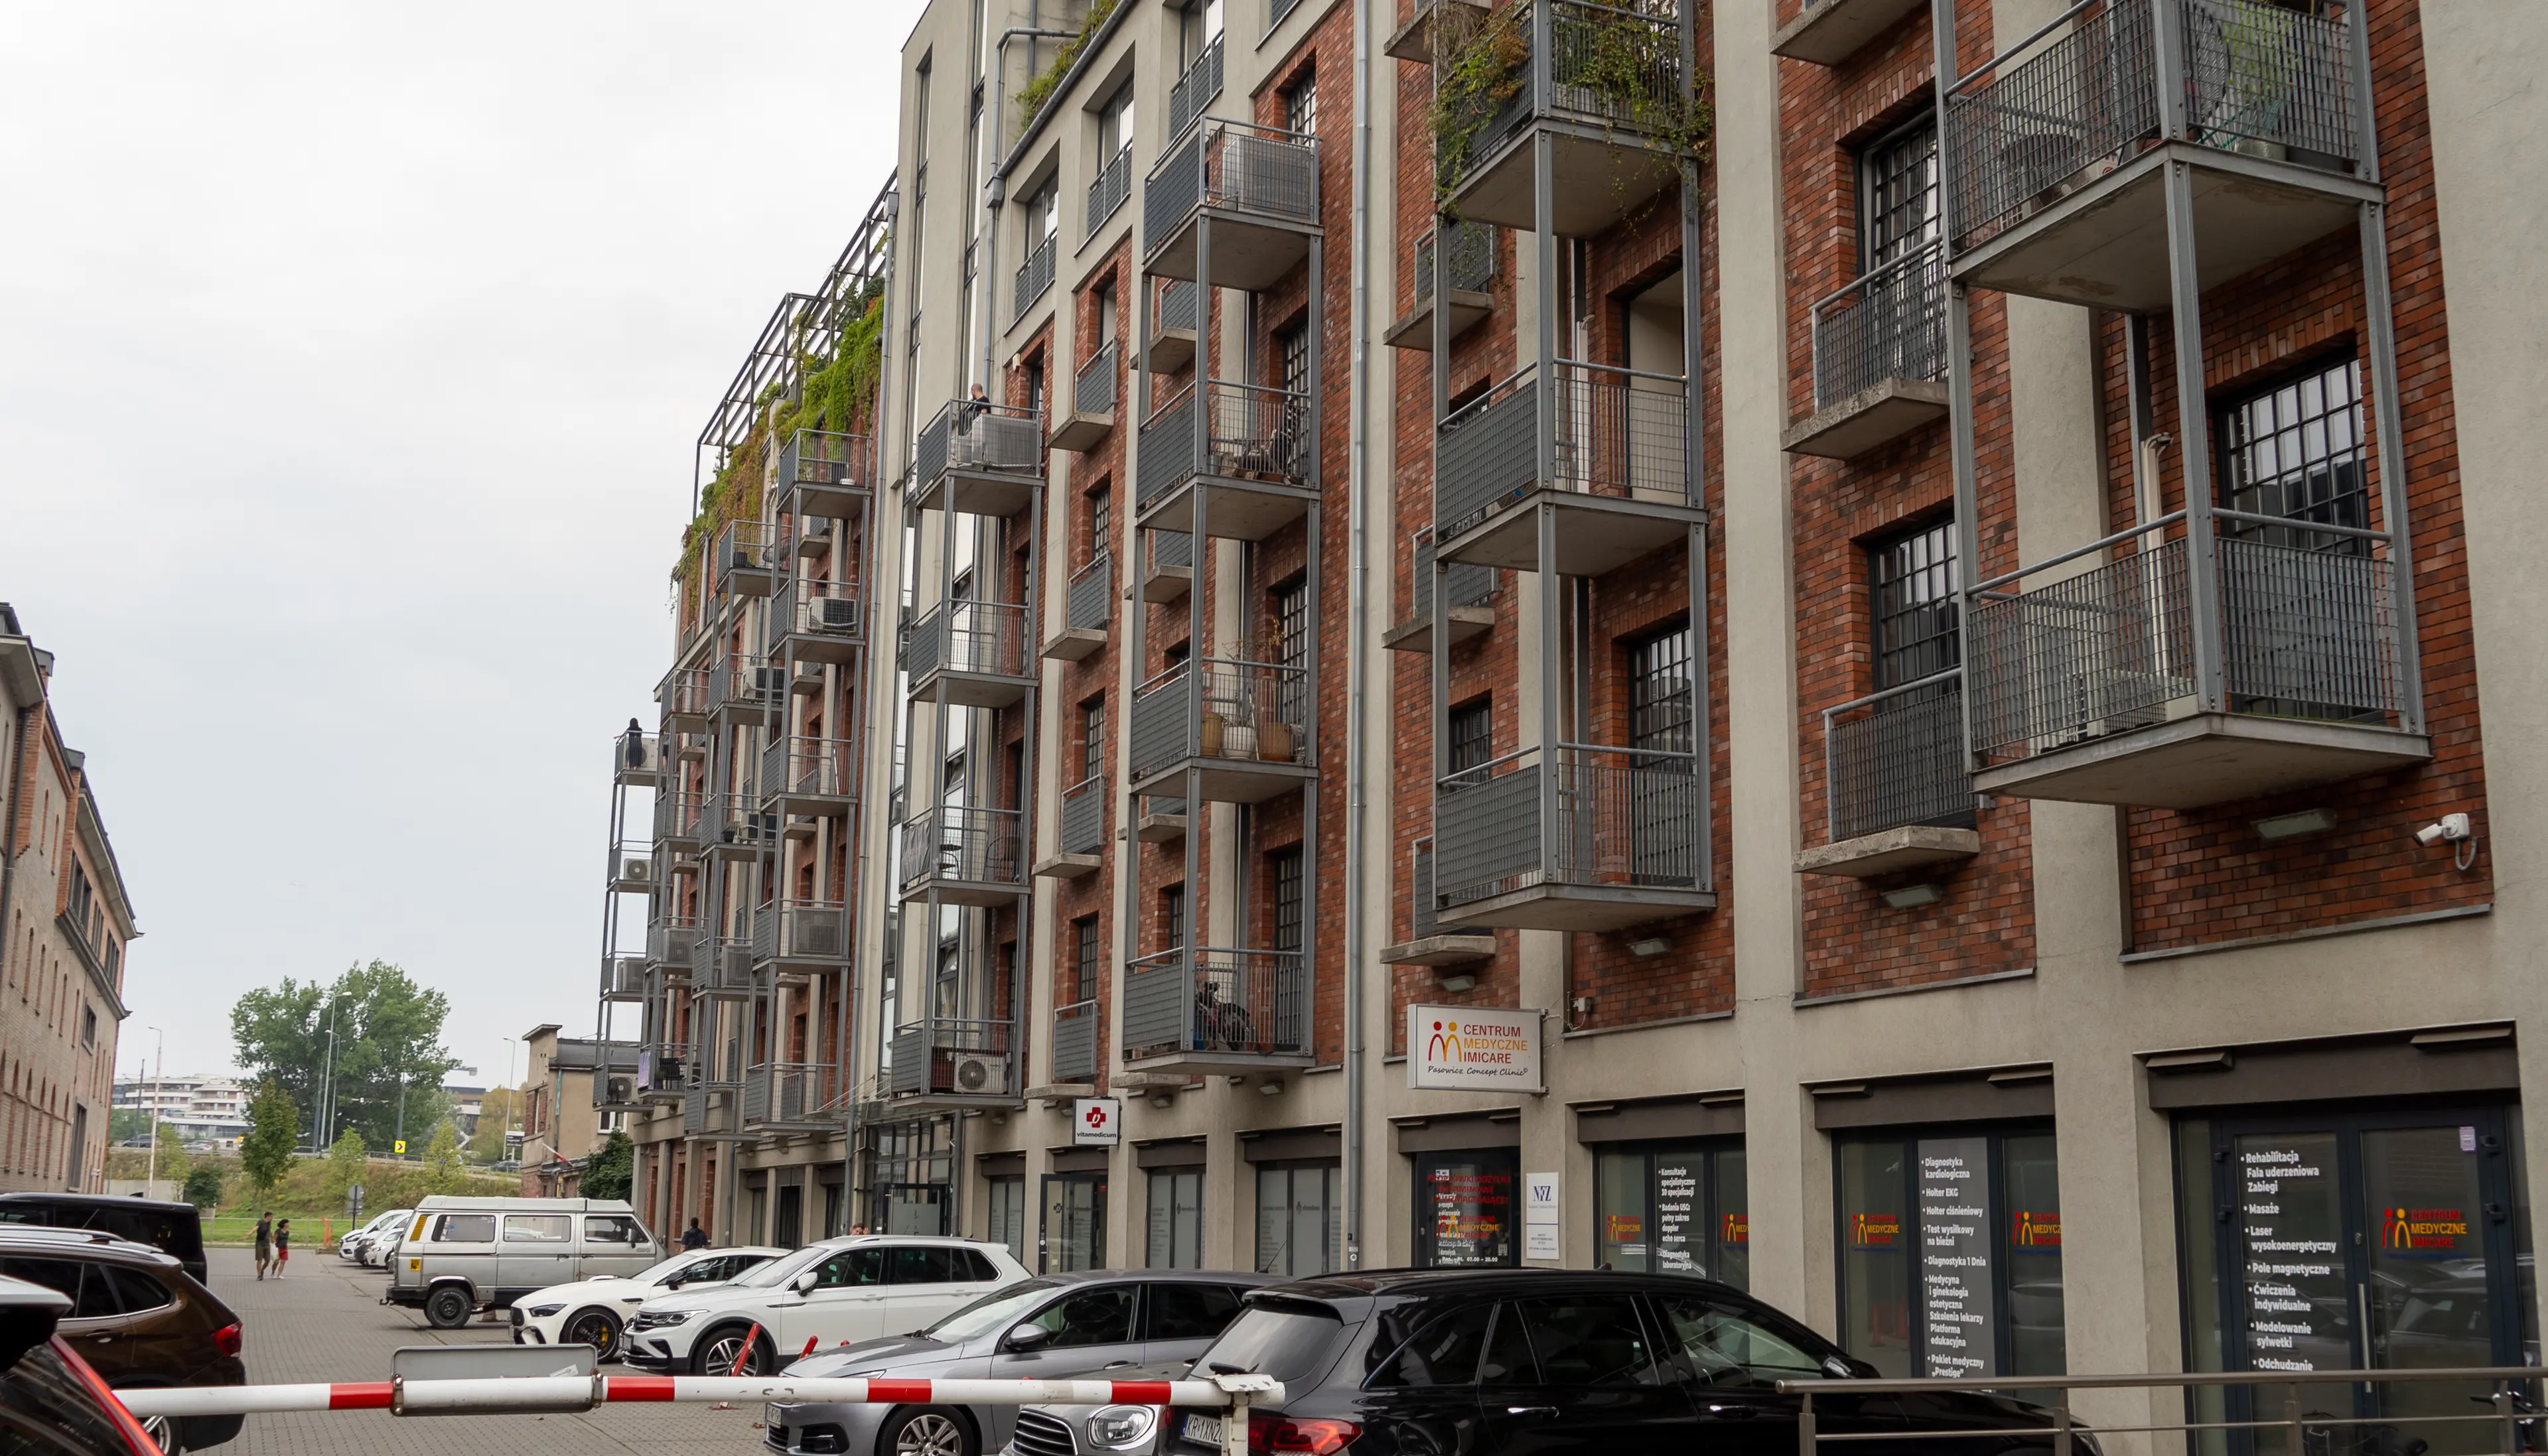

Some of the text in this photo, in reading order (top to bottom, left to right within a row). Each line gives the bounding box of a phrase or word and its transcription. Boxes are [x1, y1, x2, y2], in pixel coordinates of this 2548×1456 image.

[1464, 1024, 1521, 1037] CENTRUM
[1464, 1038, 1528, 1051] MEDYCZNE
[1464, 1052, 1512, 1064] IMICARE
[1428, 1065, 1464, 1075] Pasowicz
[1466, 1067, 1498, 1077] Concept
[1925, 1157, 1963, 1167] Diagnostyka
[2245, 1150, 2299, 1163] Rehabilitacja
[1661, 1166, 1687, 1177] Konsultacje
[1925, 1169, 1970, 1180] kardiologiczna
[2247, 1165, 2319, 1178] Fala uderzeniowa
[1533, 1185, 1551, 1201] NFZ
[1926, 1188, 1959, 1197] Holter EKG
[2247, 1181, 2279, 1193] Zabiegi
[1926, 1205, 1983, 1217] Holter ciśnieniowy
[2249, 1202, 2279, 1214] Masaże
[2410, 1209, 2460, 1221] CENTRUM
[1867, 1224, 1899, 1234] MEDYCZNE
[1927, 1225, 1975, 1236] Test wysiłkowy
[2250, 1226, 2273, 1236] Laser
[2411, 1223, 2468, 1235] MEDYCZNE
[1936, 1236, 1955, 1246] bieżni
[2251, 1240, 2337, 1253] wysokoenergetyczny
[2412, 1237, 2455, 1248] IMICARE
[1928, 1256, 1966, 1267] Diagnostyka
[1971, 1258, 1987, 1267] Dnia
[2252, 1262, 2330, 1277] Pole magnetyczne
[1928, 1274, 1960, 1286] Medycyna
[1932, 1287, 1969, 1297] ginekologia
[2253, 1282, 2297, 1297] Ćwiczenia
[1929, 1299, 1963, 1310] estetyczna
[2254, 1298, 2311, 1312] indywidualne
[1930, 1311, 1984, 1325] Szkolenia lekarzy
[1930, 1323, 1961, 1335] Platforma
[2255, 1321, 2312, 1335] Modelowanie
[1930, 1336, 1967, 1348] edukacyjna
[2257, 1336, 2293, 1349] sylwetki
[1931, 1354, 1985, 1369] Pakiet medyczny
[2258, 1358, 2314, 1372] Odchudzanie
[1186, 1416, 1199, 1437] KR
